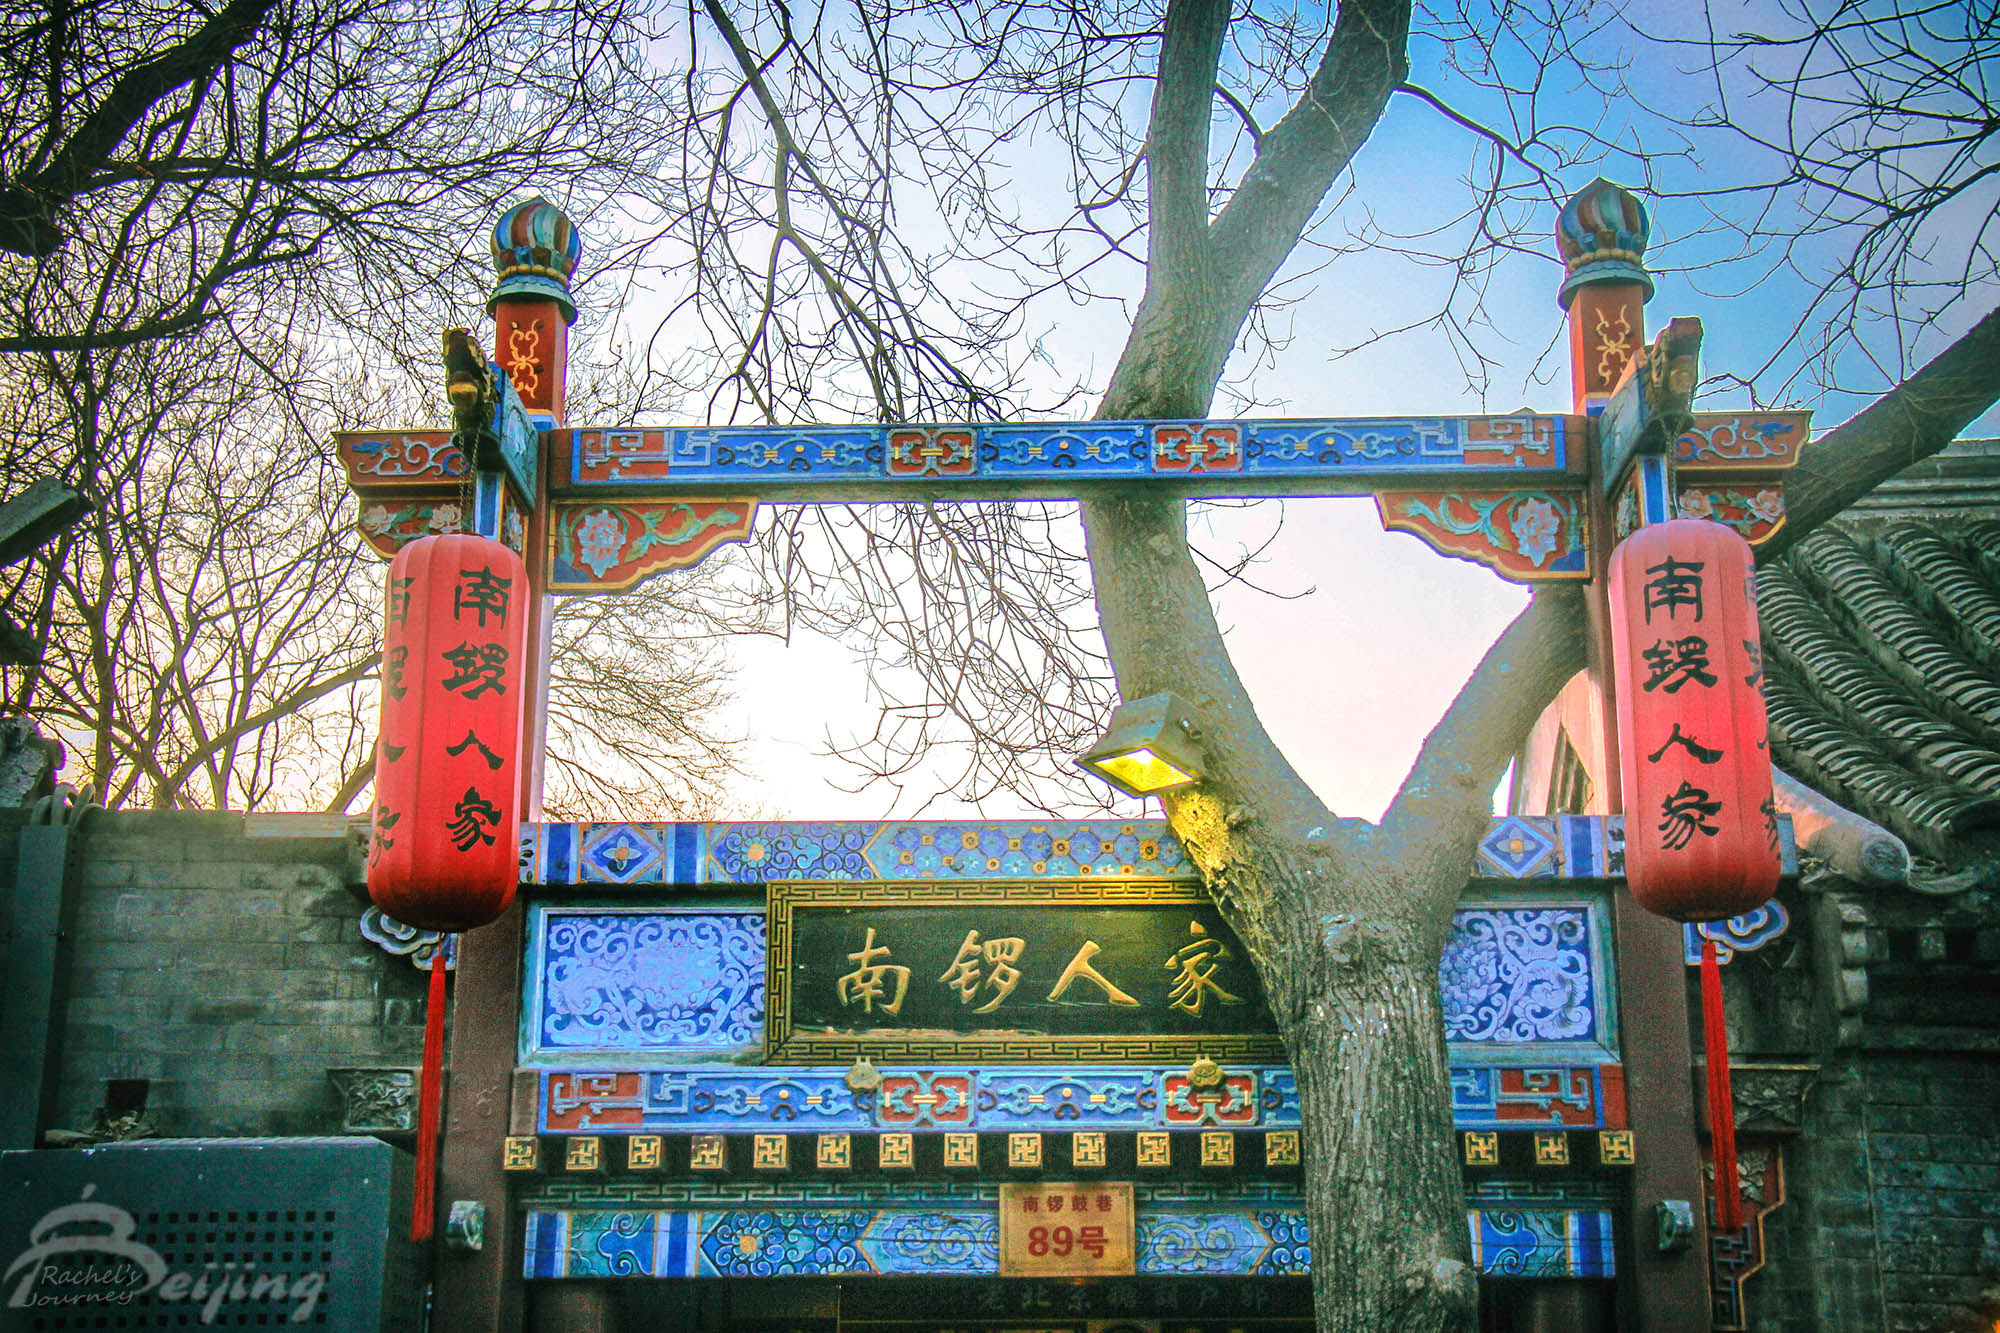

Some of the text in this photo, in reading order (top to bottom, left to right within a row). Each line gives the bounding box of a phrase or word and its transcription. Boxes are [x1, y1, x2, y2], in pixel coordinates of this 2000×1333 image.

[837, 920, 1247, 1018] 南锣人家
[1027, 1225, 1109, 1259] 89号
